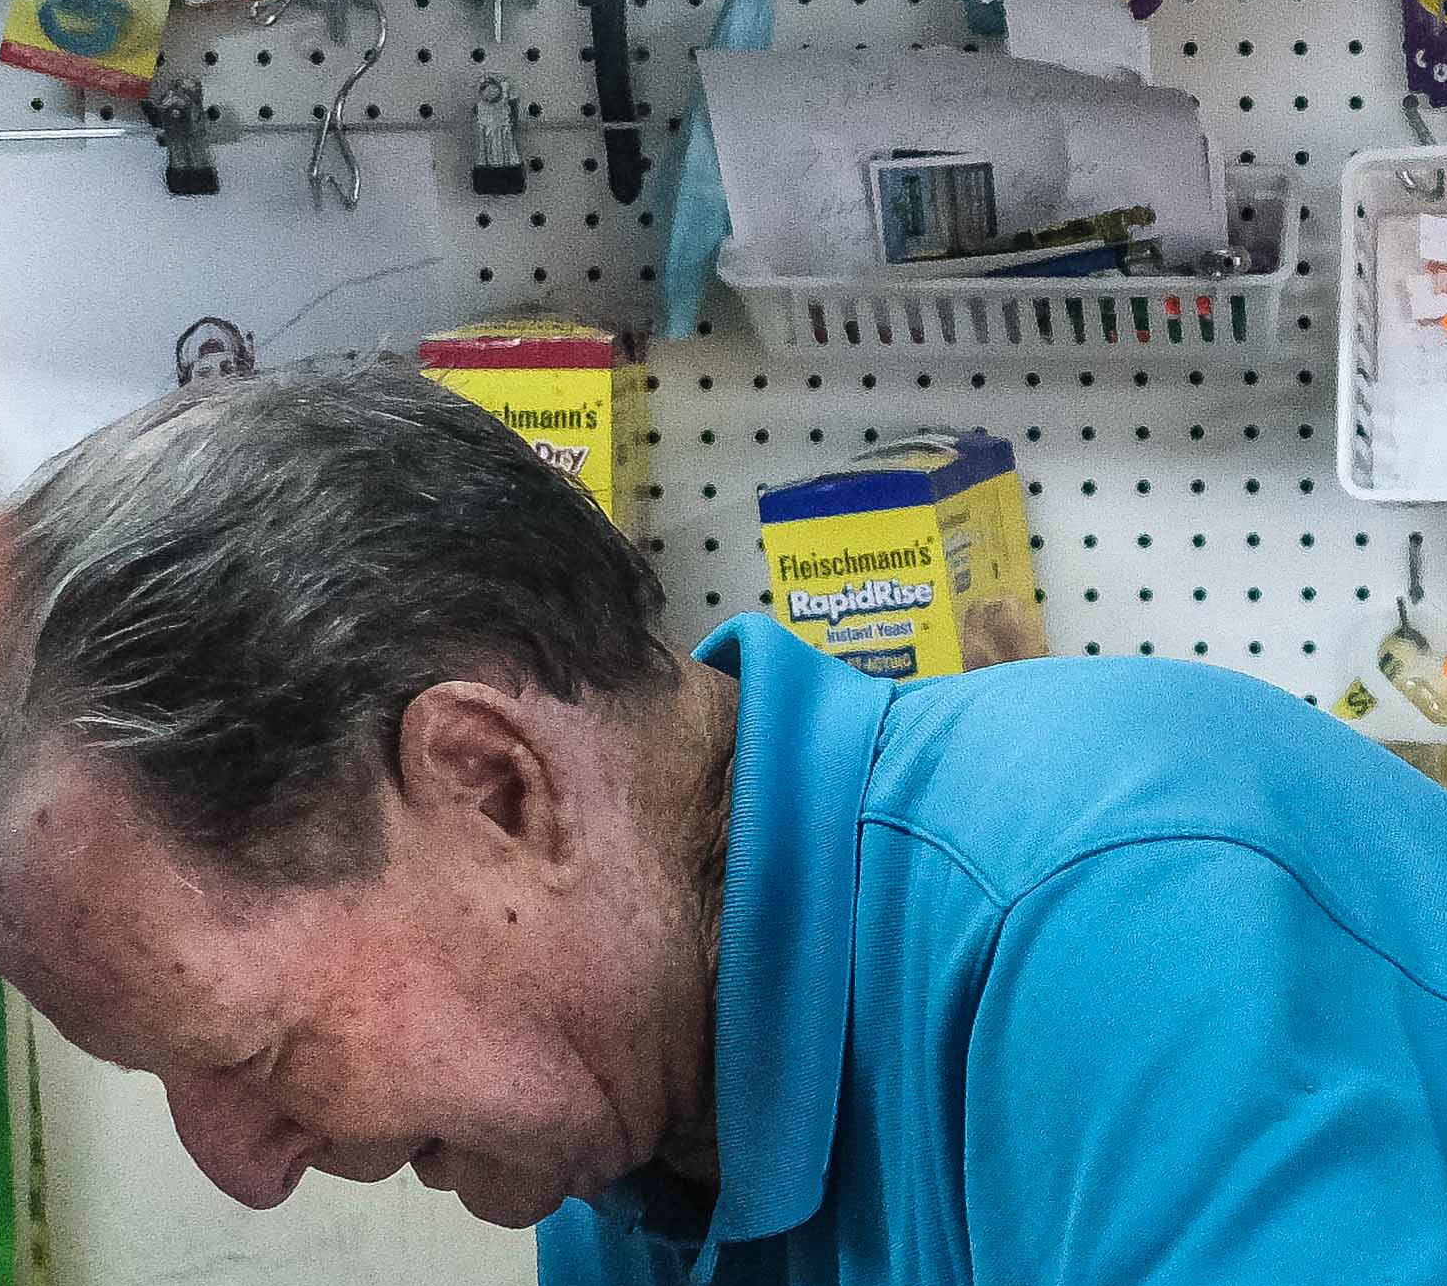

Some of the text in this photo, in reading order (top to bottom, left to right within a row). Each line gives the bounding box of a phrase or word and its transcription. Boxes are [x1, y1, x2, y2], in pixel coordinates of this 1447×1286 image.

[494, 402, 597, 429] hmann's
[778, 538, 934, 583] Fleischmann's
[788, 579, 935, 624] RapidRise
[877, 621, 914, 638] Yeast
